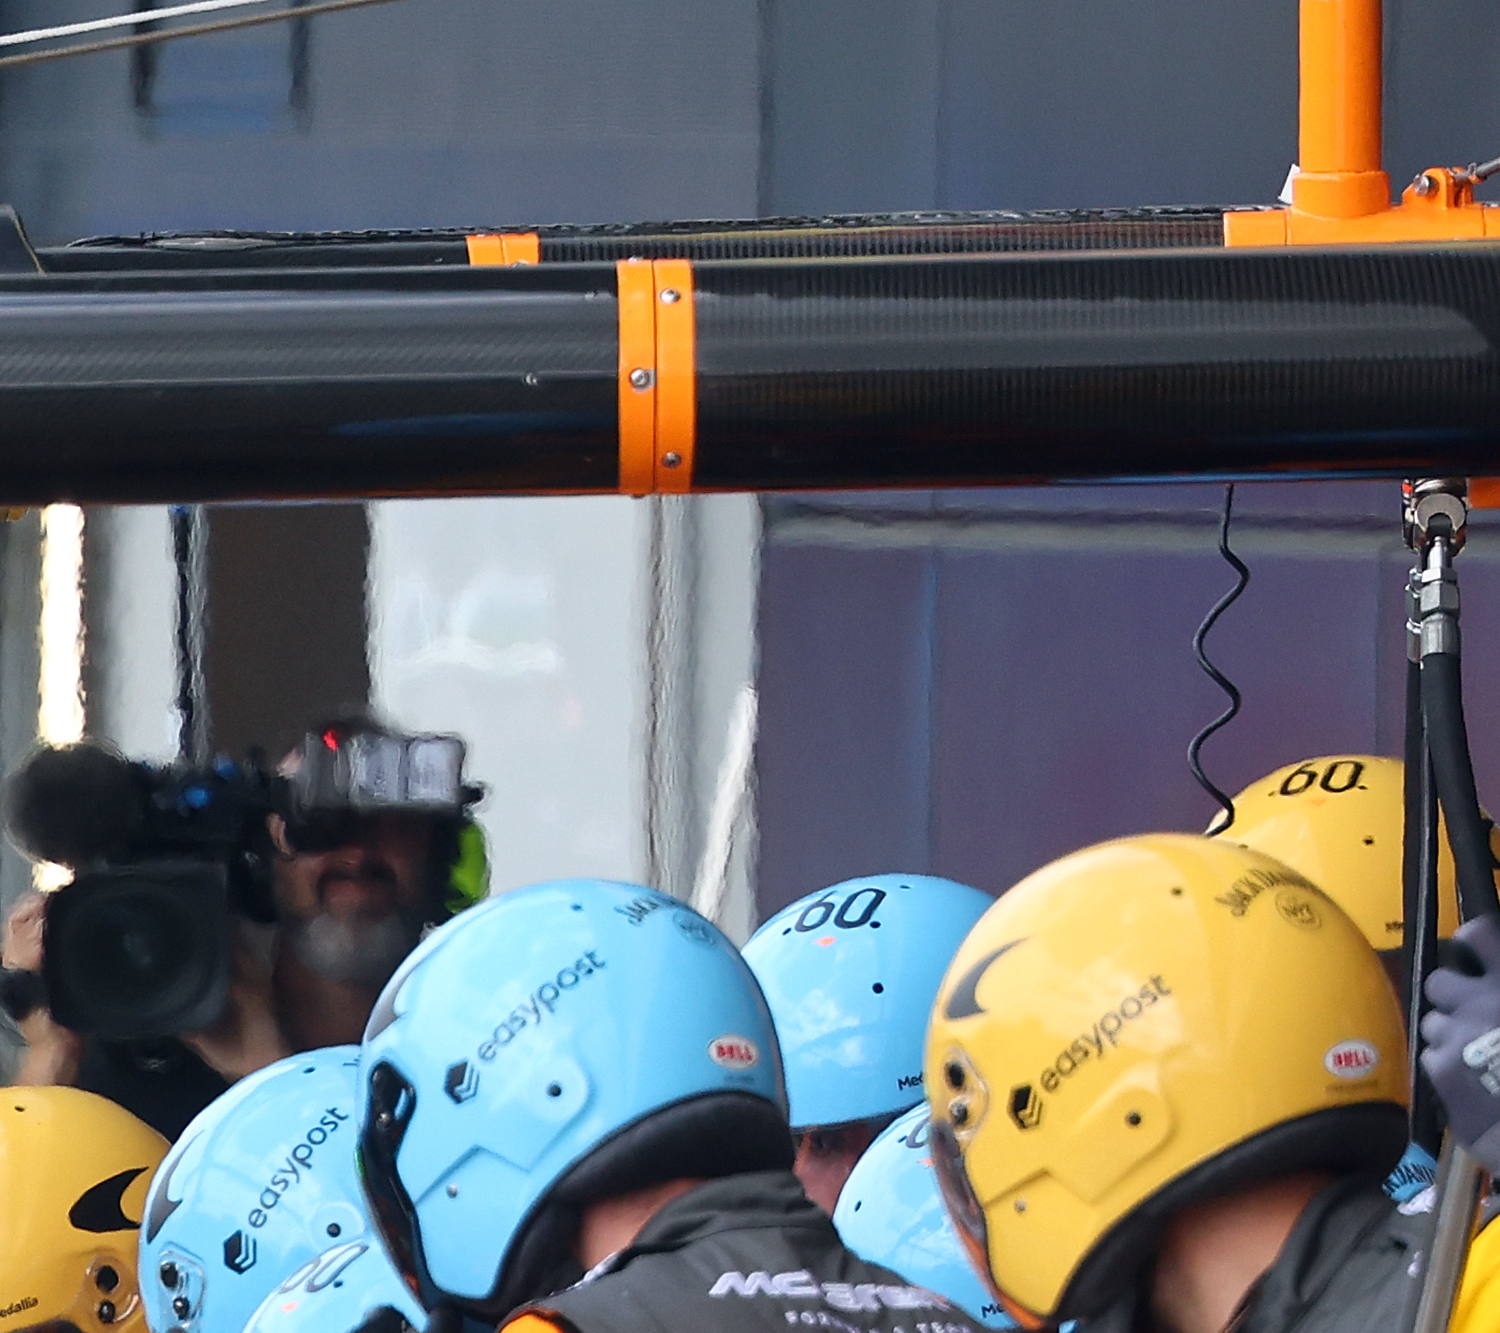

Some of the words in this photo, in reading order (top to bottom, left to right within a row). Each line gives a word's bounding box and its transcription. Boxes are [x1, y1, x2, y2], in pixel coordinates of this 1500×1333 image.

[1278, 760, 1366, 796] 60
[794, 886, 888, 932] 60
[477, 947, 606, 1064] easypost
[1039, 972, 1172, 1094] easypost
[246, 1104, 350, 1232] easypost
